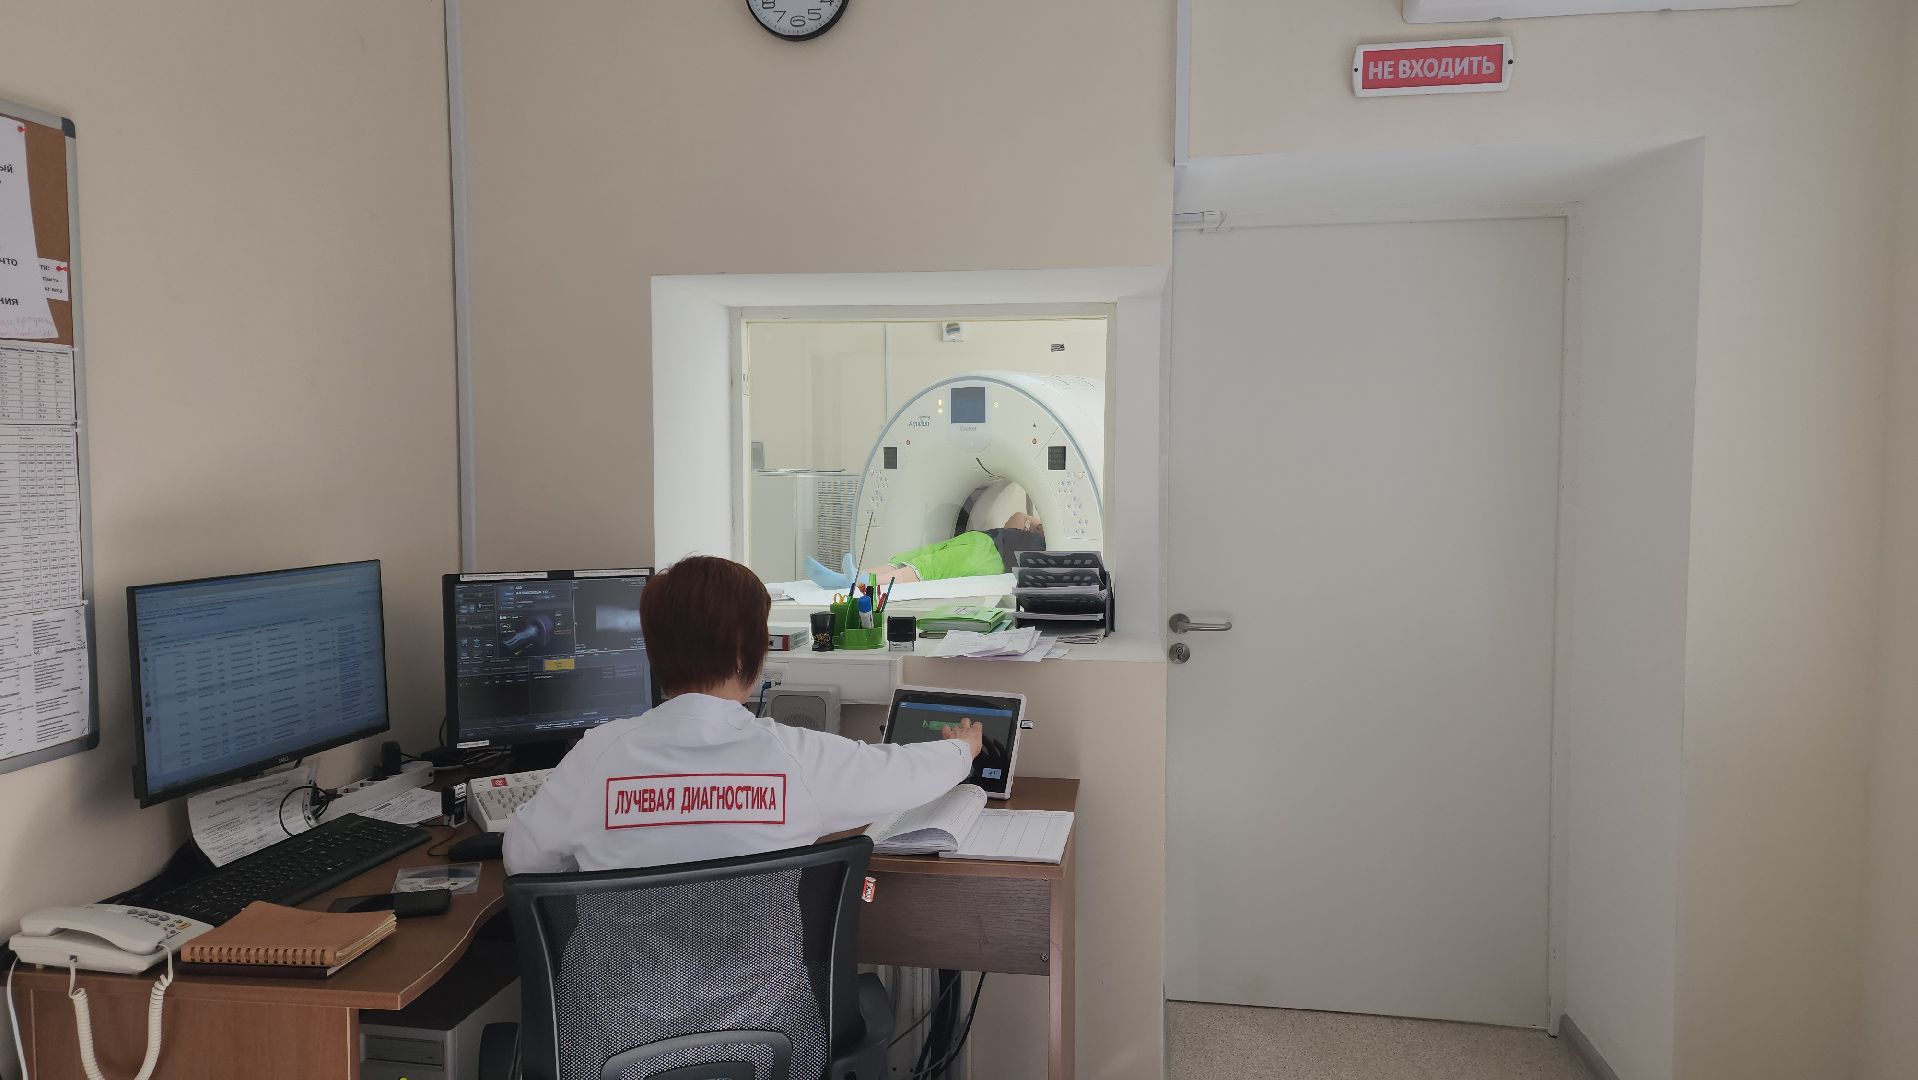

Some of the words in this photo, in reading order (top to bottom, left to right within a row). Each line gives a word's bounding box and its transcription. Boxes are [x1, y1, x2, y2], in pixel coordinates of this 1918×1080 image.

[772, 10, 787, 23] 7
[807, 8, 822, 21] 5
[789, 15, 806, 28] 6
[1368, 60, 1395, 80] НЕ
[1398, 55, 1496, 79] ВХОДИТЬ
[614, 787, 676, 815] ЛУЧЕВАЯ
[680, 785, 777, 815] ДИАГНОСТИКА
